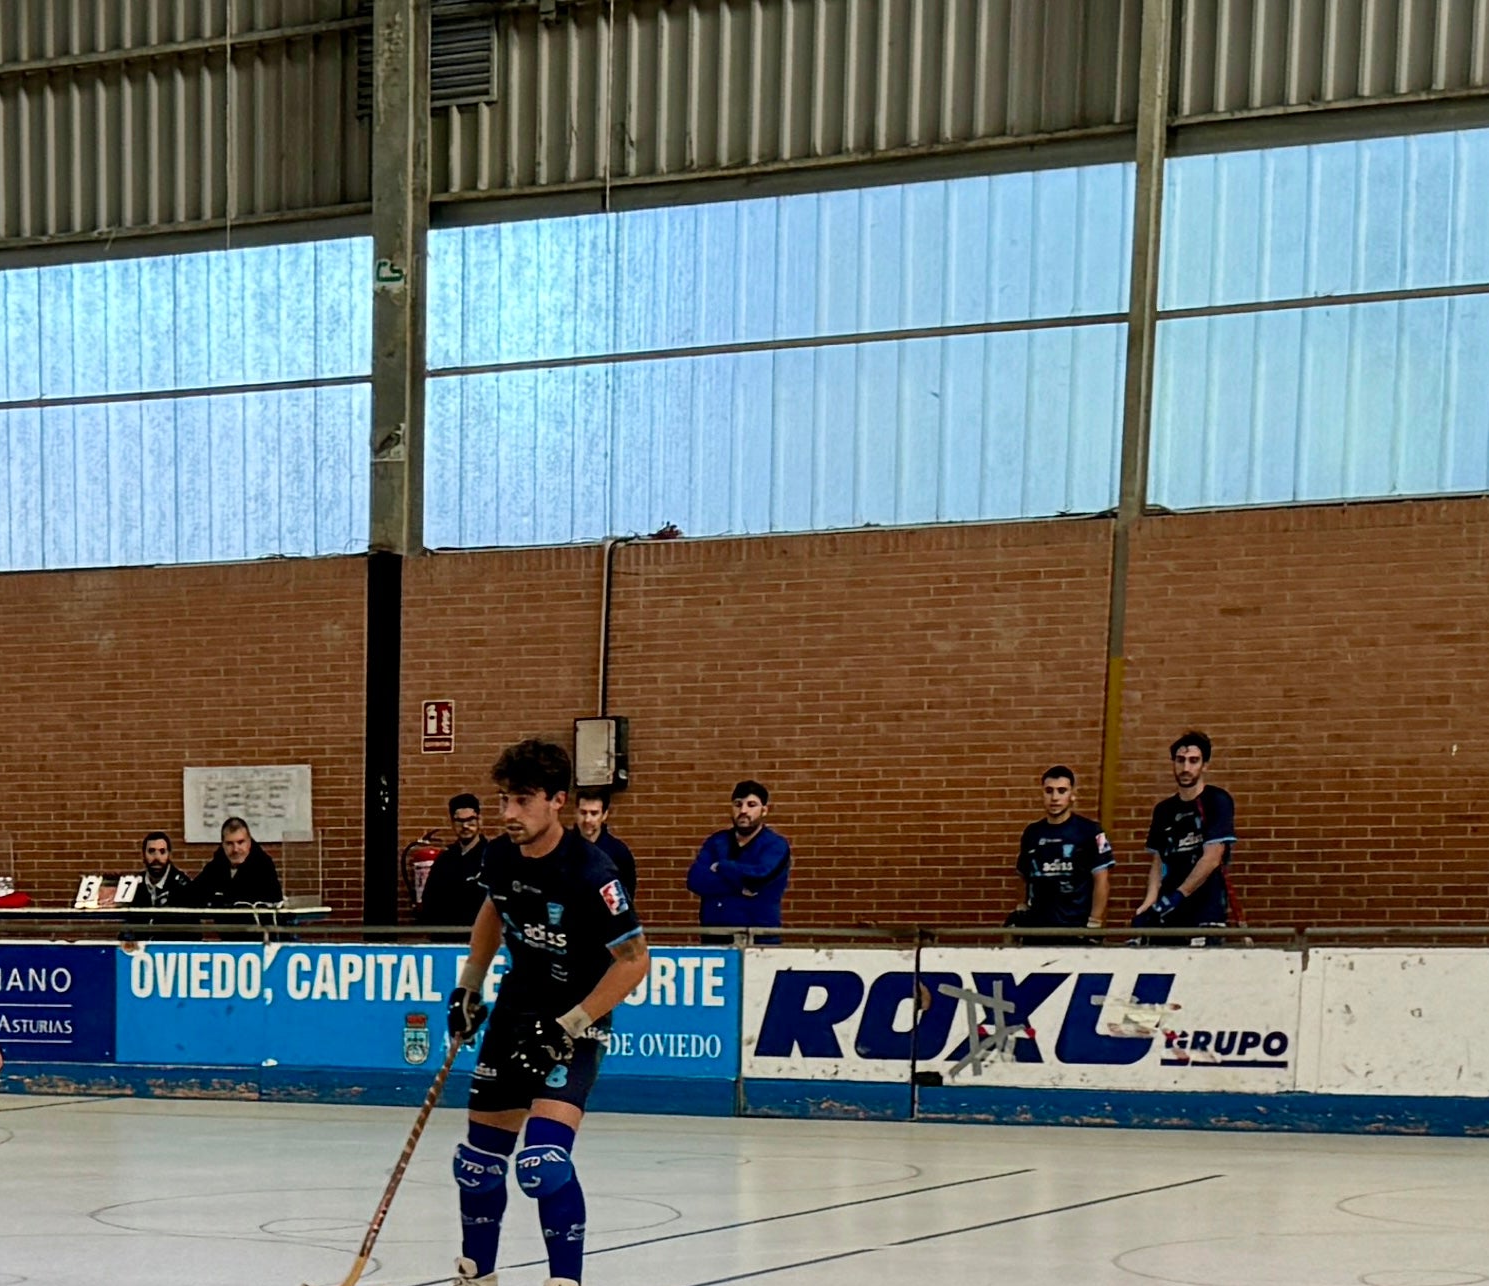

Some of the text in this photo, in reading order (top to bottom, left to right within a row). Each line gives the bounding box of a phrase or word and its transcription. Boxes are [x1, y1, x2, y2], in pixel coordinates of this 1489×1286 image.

[82, 881, 94, 900] 5
[122, 881, 132, 899] 7
[286, 953, 442, 1002] CAPITAL
[753, 969, 1177, 1066] ROXU
[606, 1032, 634, 1056] DE
[639, 1033, 722, 1058] OVIEDO
[1164, 1031, 1289, 1058] GRUPO
